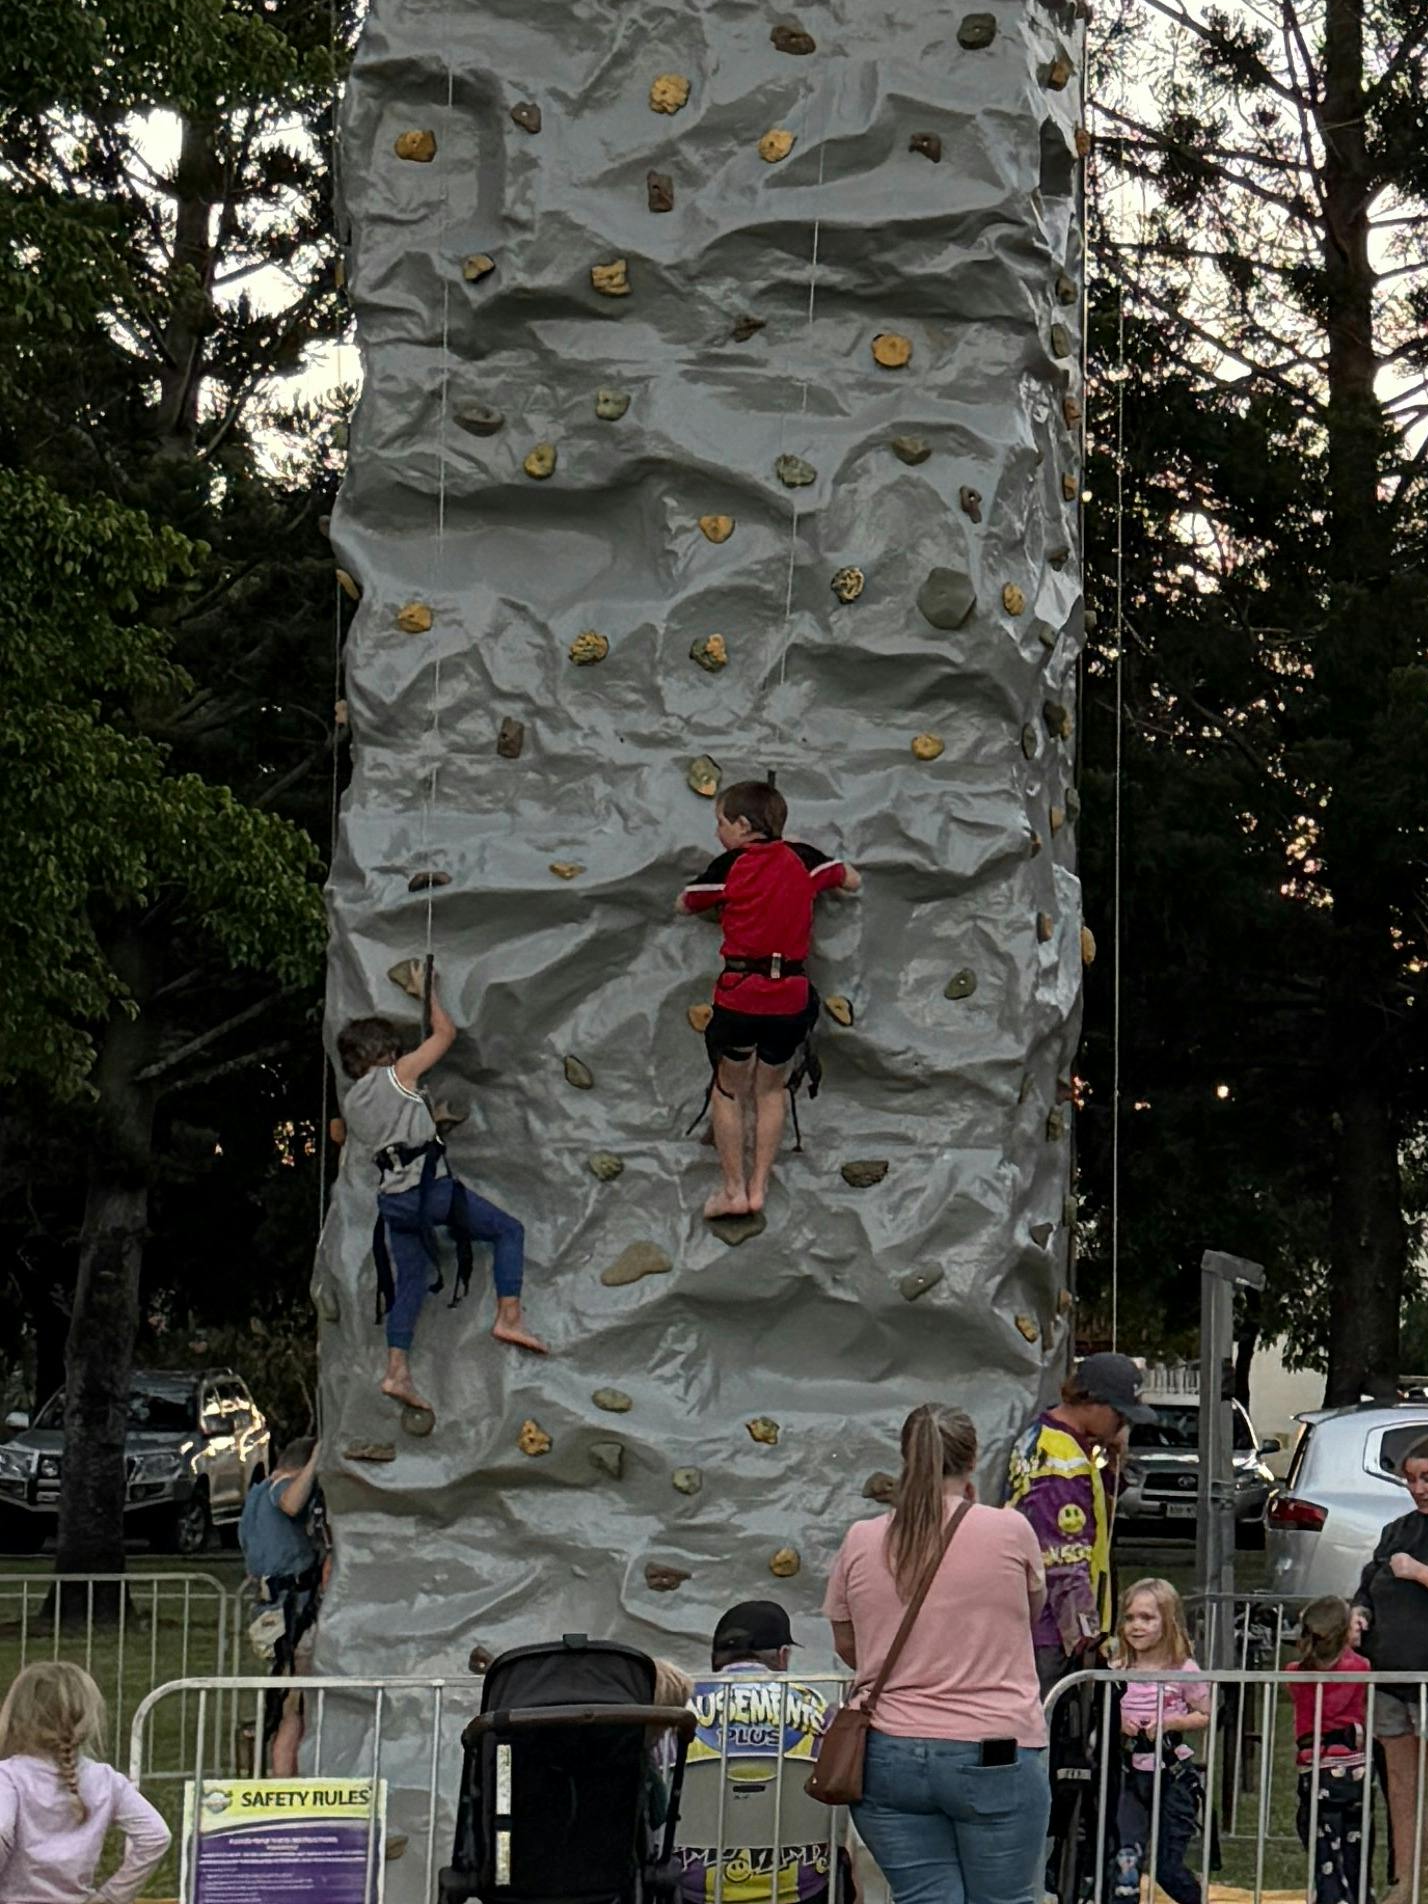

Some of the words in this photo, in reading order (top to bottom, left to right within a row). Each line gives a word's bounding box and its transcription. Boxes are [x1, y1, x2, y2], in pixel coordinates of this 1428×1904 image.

[717, 1726, 781, 1746] PLUS
[241, 1790, 309, 1808] SAFETY
[312, 1789, 370, 1806] RULES
